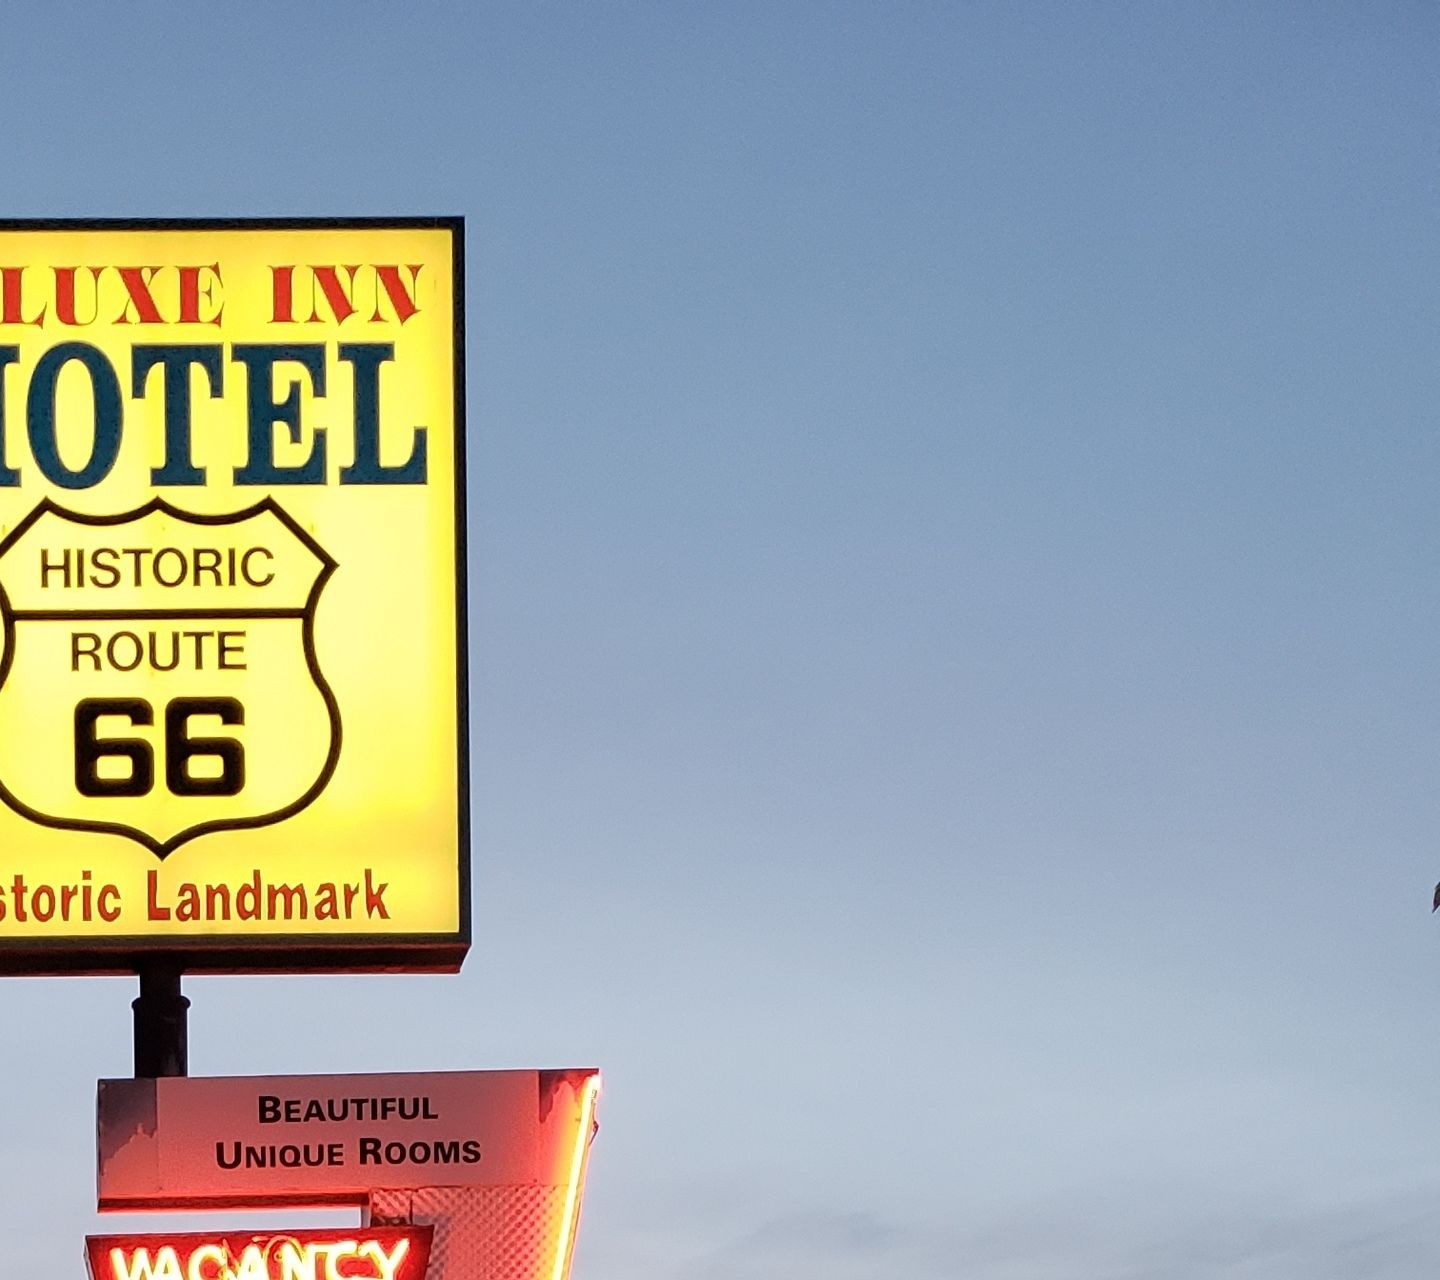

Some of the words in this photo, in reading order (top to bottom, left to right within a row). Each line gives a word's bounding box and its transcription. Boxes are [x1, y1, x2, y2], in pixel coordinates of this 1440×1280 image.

[267, 263, 424, 326] INN
[40, 546, 275, 589] HISTORIC
[71, 631, 247, 672] ROUTE
[74, 696, 245, 797] 66
[146, 868, 390, 923] Landmark
[258, 1095, 438, 1124] BEAUTIFUL
[215, 1140, 345, 1170] UNIQUE
[358, 1137, 482, 1165] ROOMS
